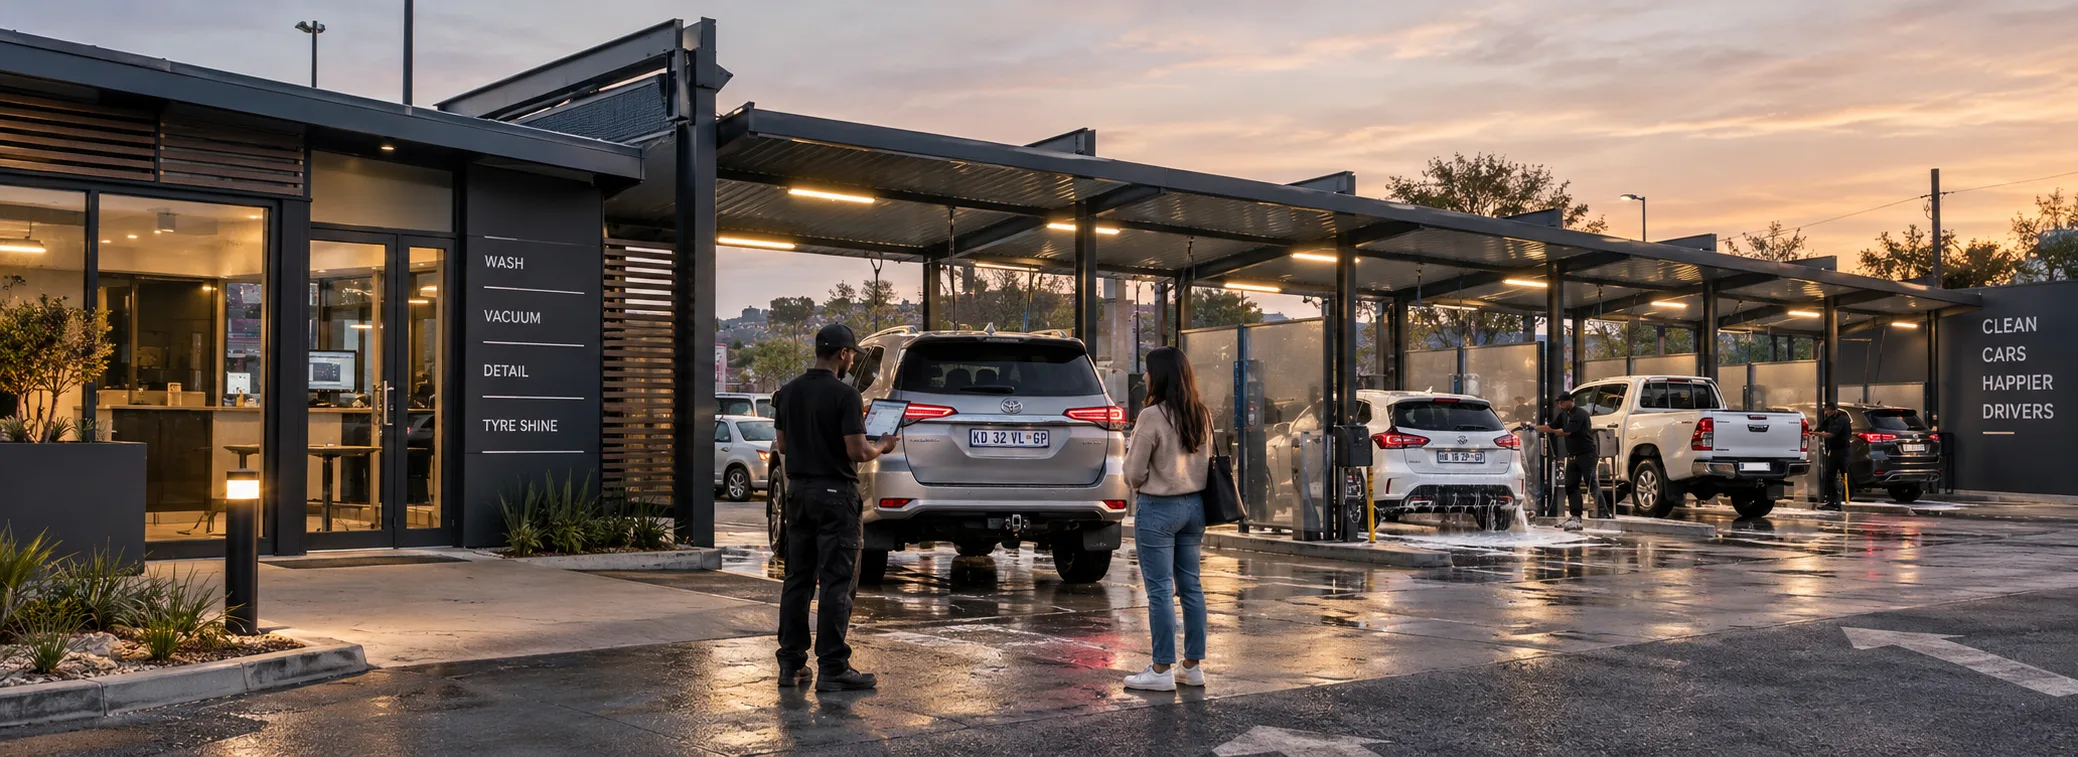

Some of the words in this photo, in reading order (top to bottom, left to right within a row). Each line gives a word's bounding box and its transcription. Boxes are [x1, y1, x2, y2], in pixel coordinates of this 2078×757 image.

[484, 254, 524, 270] WASH
[484, 309, 541, 325] VACUUM
[1982, 316, 2037, 335] CLEAN
[1982, 345, 2027, 363] CARS
[483, 363, 529, 378] DETAIL
[1982, 373, 2054, 391] HAPPIER
[1982, 402, 2055, 420] DRIVERS
[482, 418, 516, 432] TYRE
[519, 419, 558, 432] SHINE
[973, 431, 988, 444] KD
[993, 431, 1007, 444] 32
[1011, 432, 1025, 444] VL
